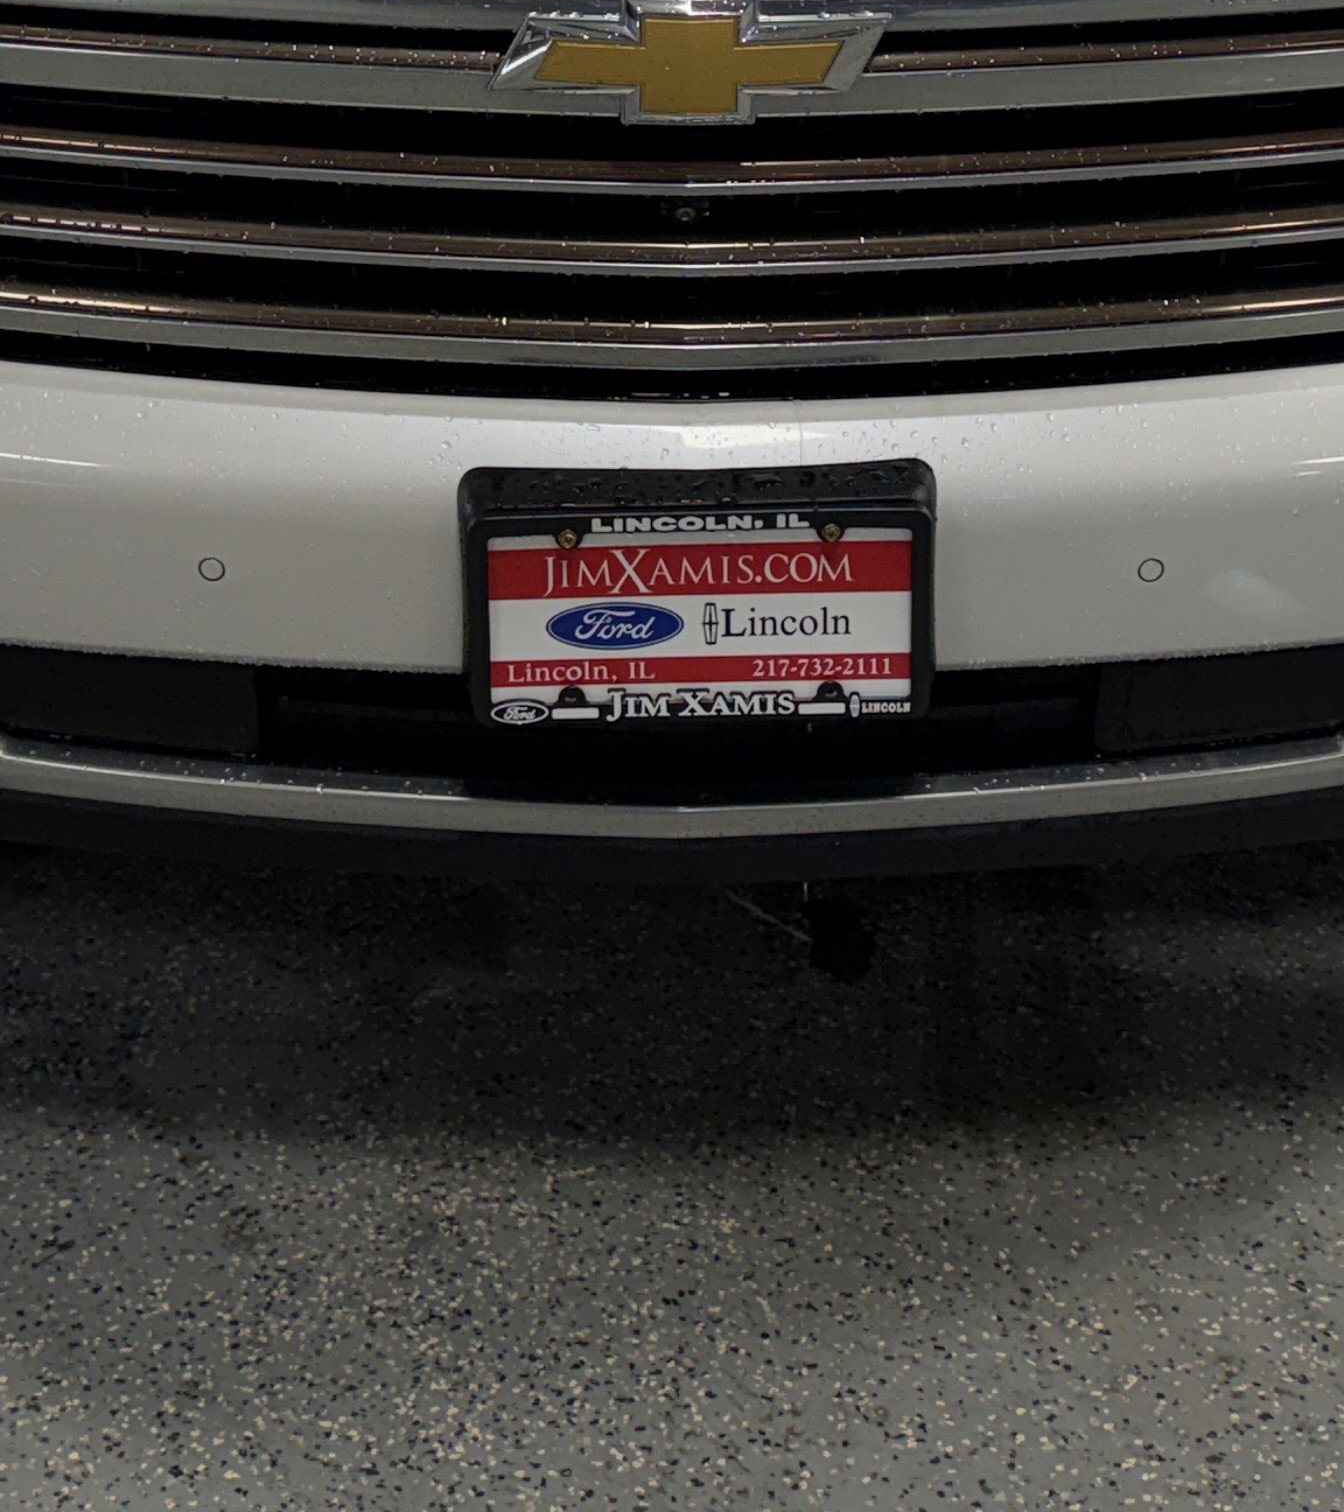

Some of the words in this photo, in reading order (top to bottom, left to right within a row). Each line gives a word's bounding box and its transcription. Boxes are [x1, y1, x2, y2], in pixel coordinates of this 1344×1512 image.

[776, 513, 810, 529] IL
[543, 548, 854, 598] JIMXAMIS.COM
[574, 608, 655, 640] Ford
[720, 606, 852, 638] Lincoln
[508, 661, 617, 683] Lincoln,
[629, 660, 655, 680] IL
[752, 657, 893, 678] 217-732-2111
[606, 690, 672, 723] JIM
[677, 690, 796, 717] XAMIS
[861, 701, 911, 714] LINCOLN
